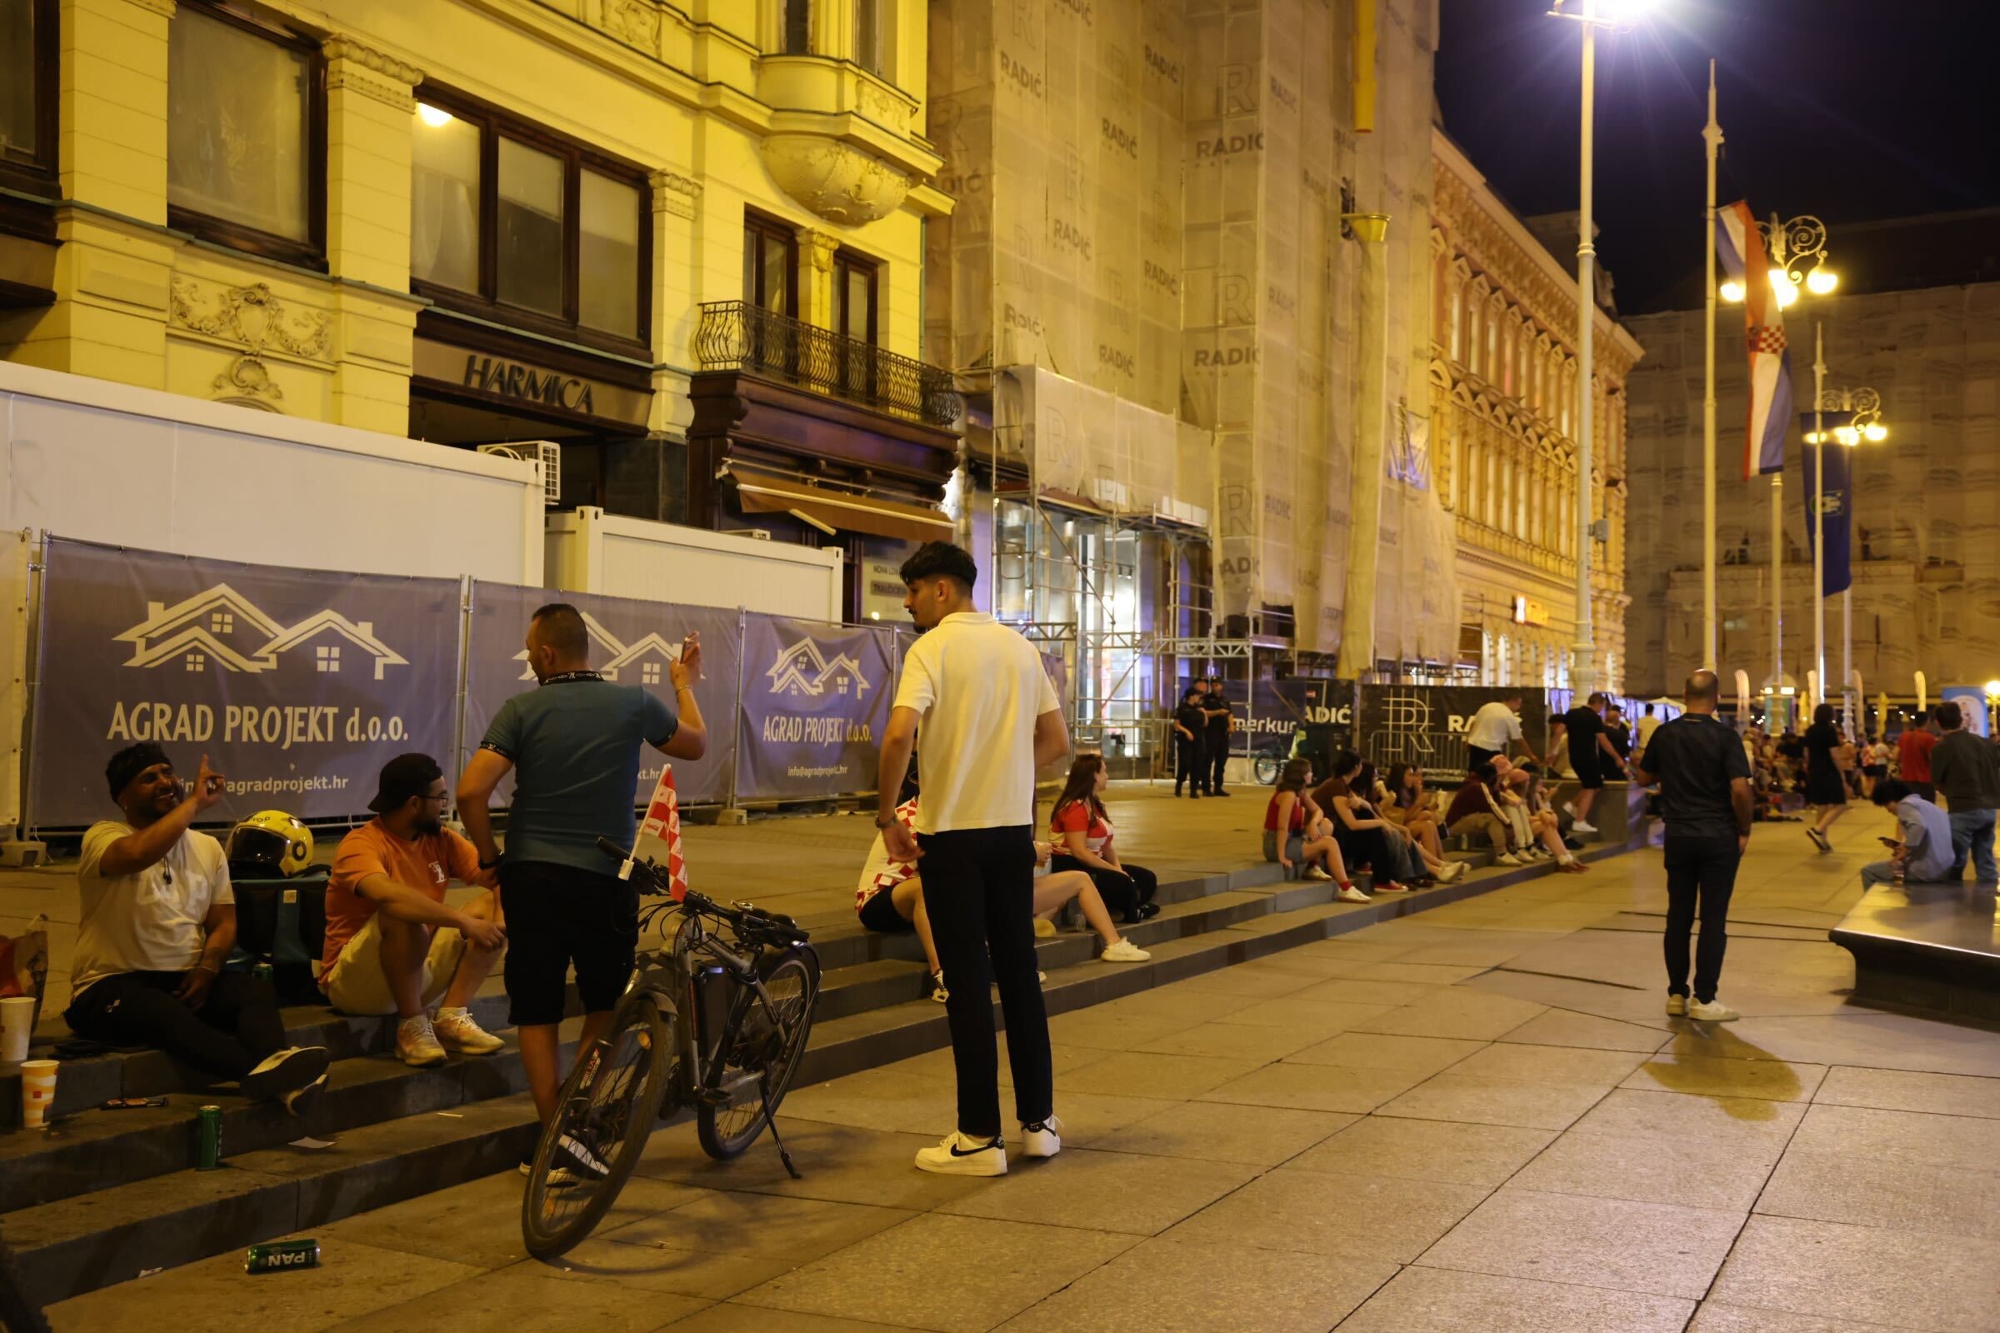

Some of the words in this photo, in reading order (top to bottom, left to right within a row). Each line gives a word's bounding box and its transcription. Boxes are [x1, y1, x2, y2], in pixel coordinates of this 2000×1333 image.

[463, 354, 594, 415] HARMICA
[106, 701, 214, 741] AGRAD
[224, 705, 339, 750] PROJEKT
[345, 708, 409, 742] d.o.o.
[1305, 704, 1352, 725] ADIĆ
[763, 715, 802, 742] AGRAD
[804, 717, 844, 747] PROJEKT
[267, 1251, 306, 1267] PAN
